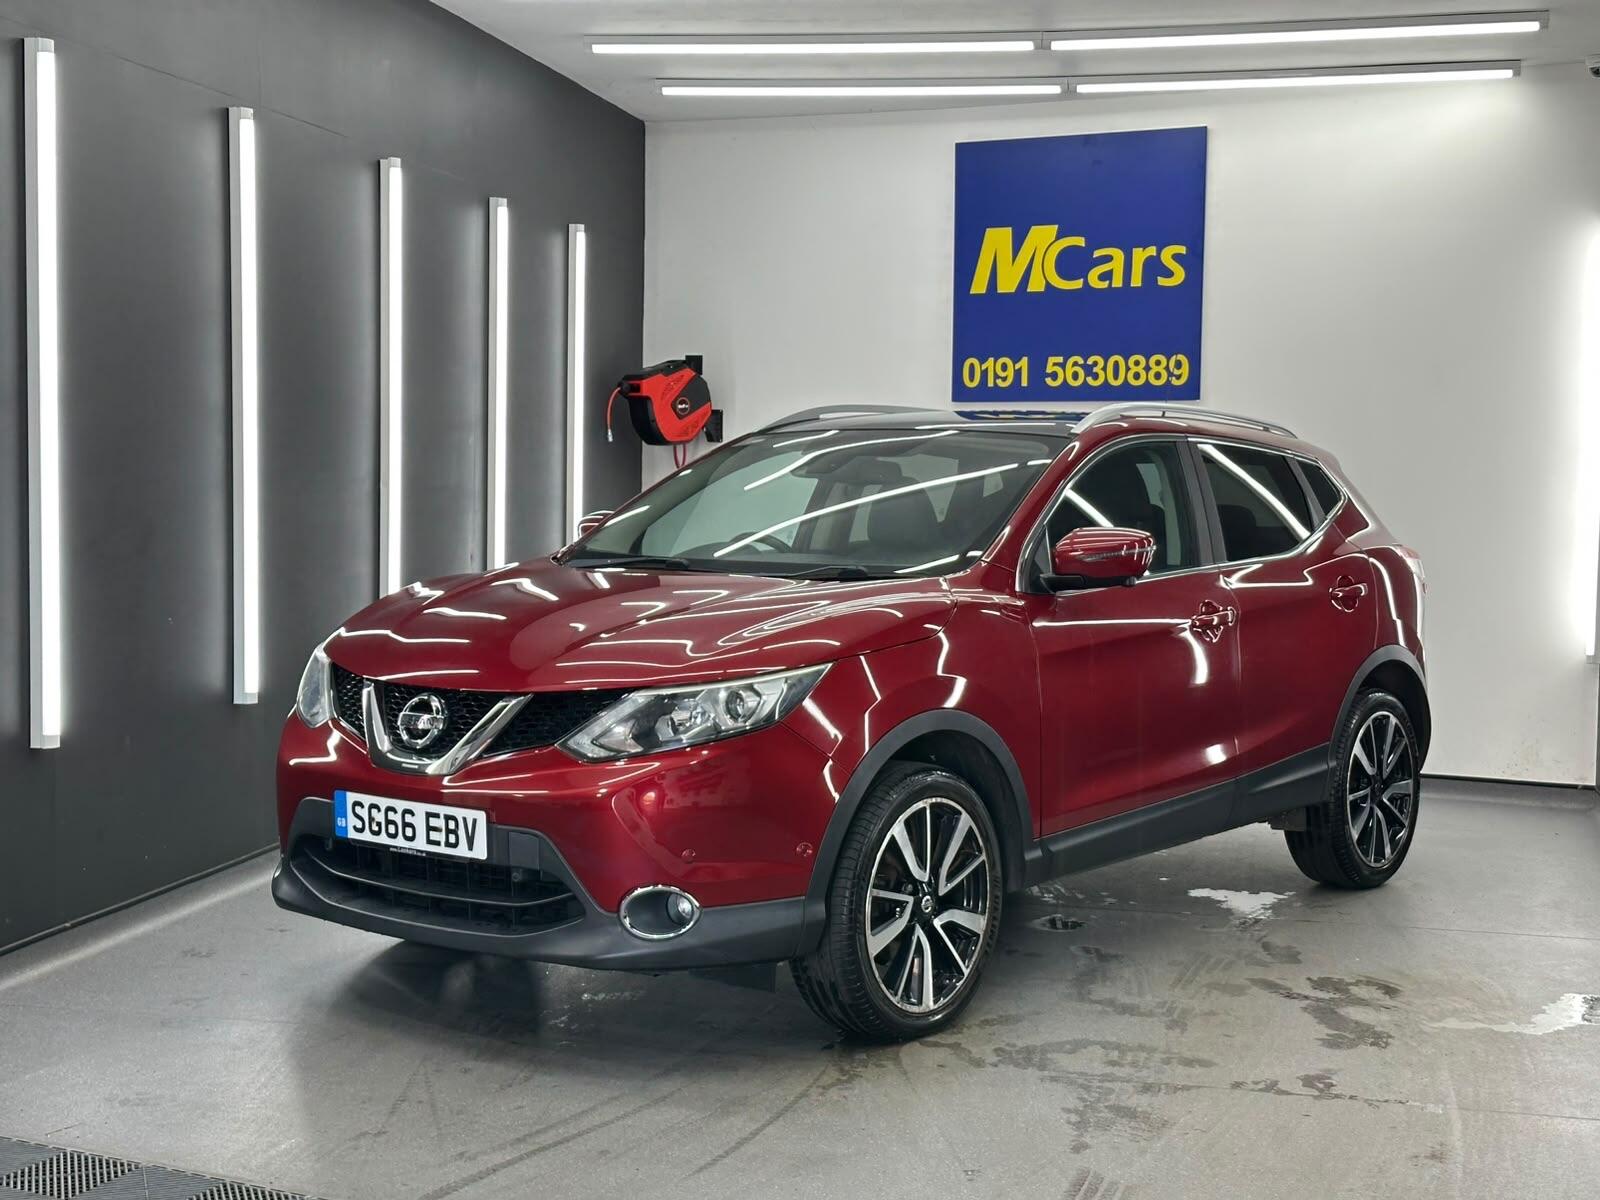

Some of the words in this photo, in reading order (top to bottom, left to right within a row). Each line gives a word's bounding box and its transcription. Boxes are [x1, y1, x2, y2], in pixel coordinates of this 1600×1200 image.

[962, 356, 1029, 388] 0191
[1044, 354, 1190, 387] 5630889
[351, 800, 417, 842] SG66
[425, 811, 477, 852] EBV
